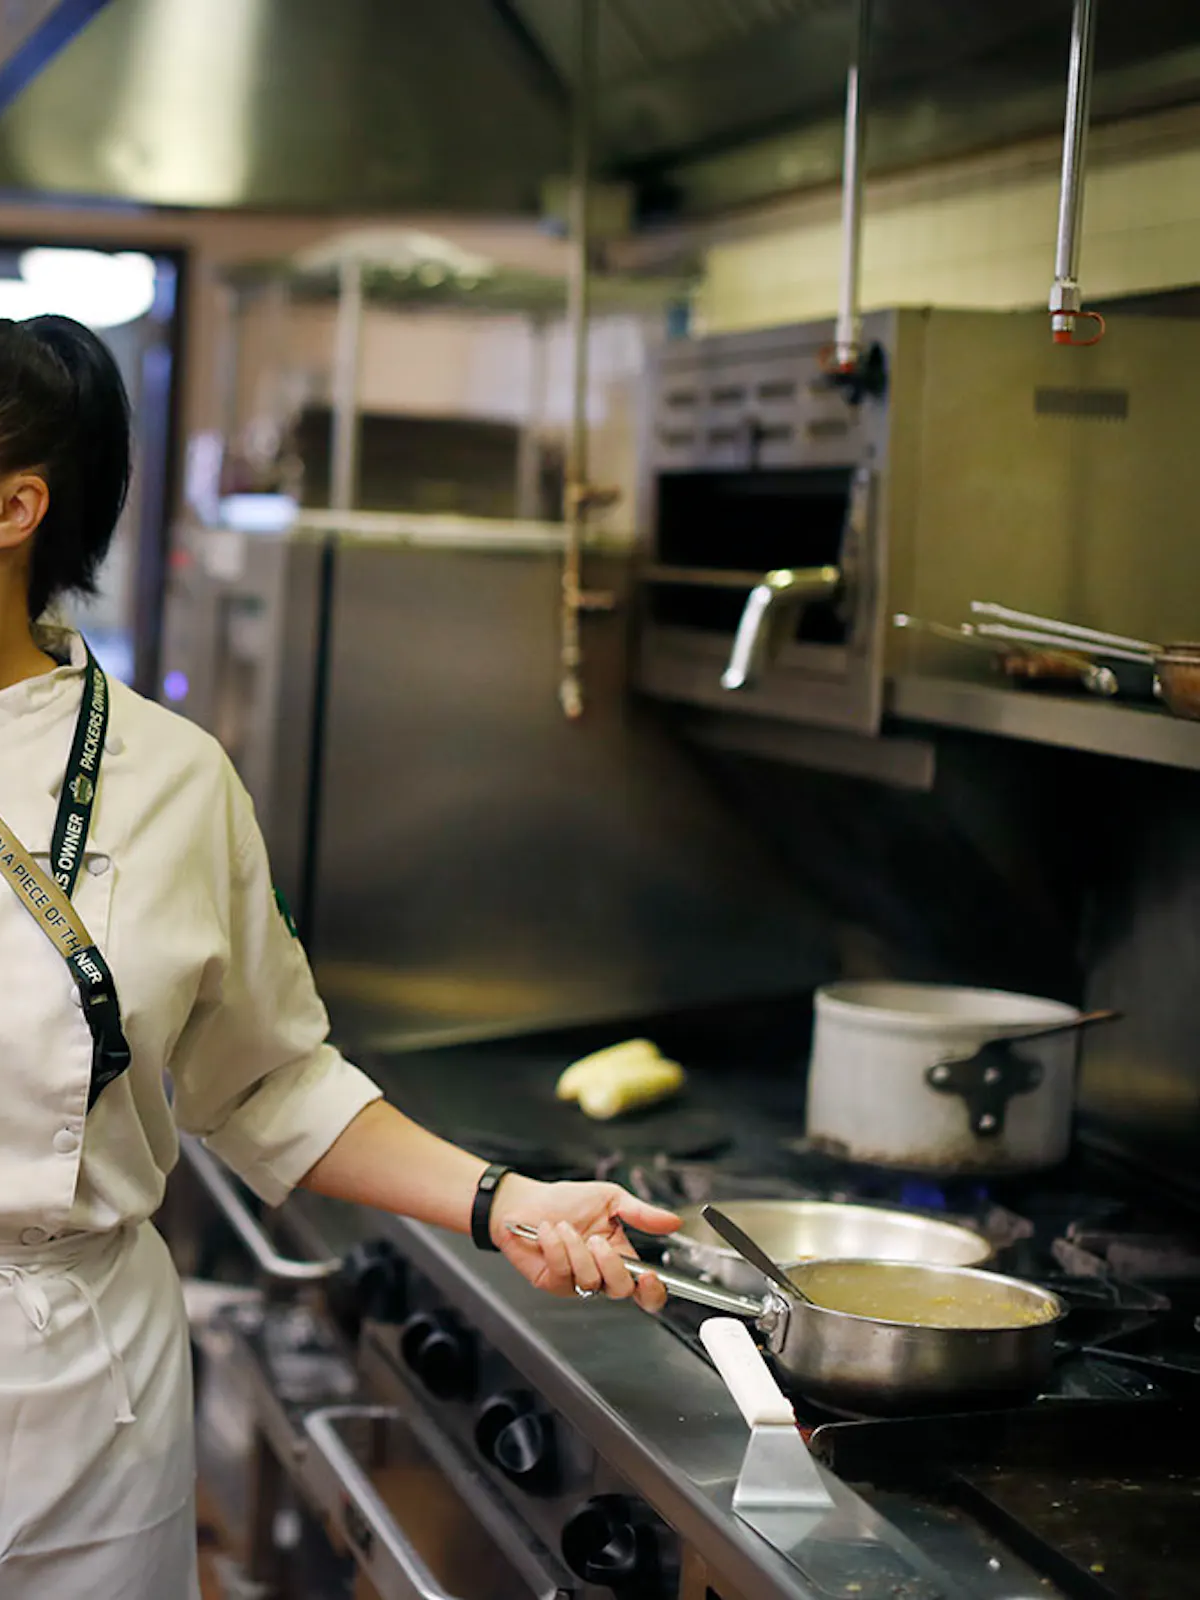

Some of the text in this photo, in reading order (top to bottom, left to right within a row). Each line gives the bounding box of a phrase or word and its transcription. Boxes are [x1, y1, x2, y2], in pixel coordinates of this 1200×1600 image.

[79, 710, 104, 771] PACKERS
[58, 813, 84, 869] OWNER
[2, 853, 14, 866] A
[13, 864, 50, 909] PIECE
[44, 906, 67, 928] OF
[60, 928, 83, 954] TH
[74, 952, 103, 984] NER
